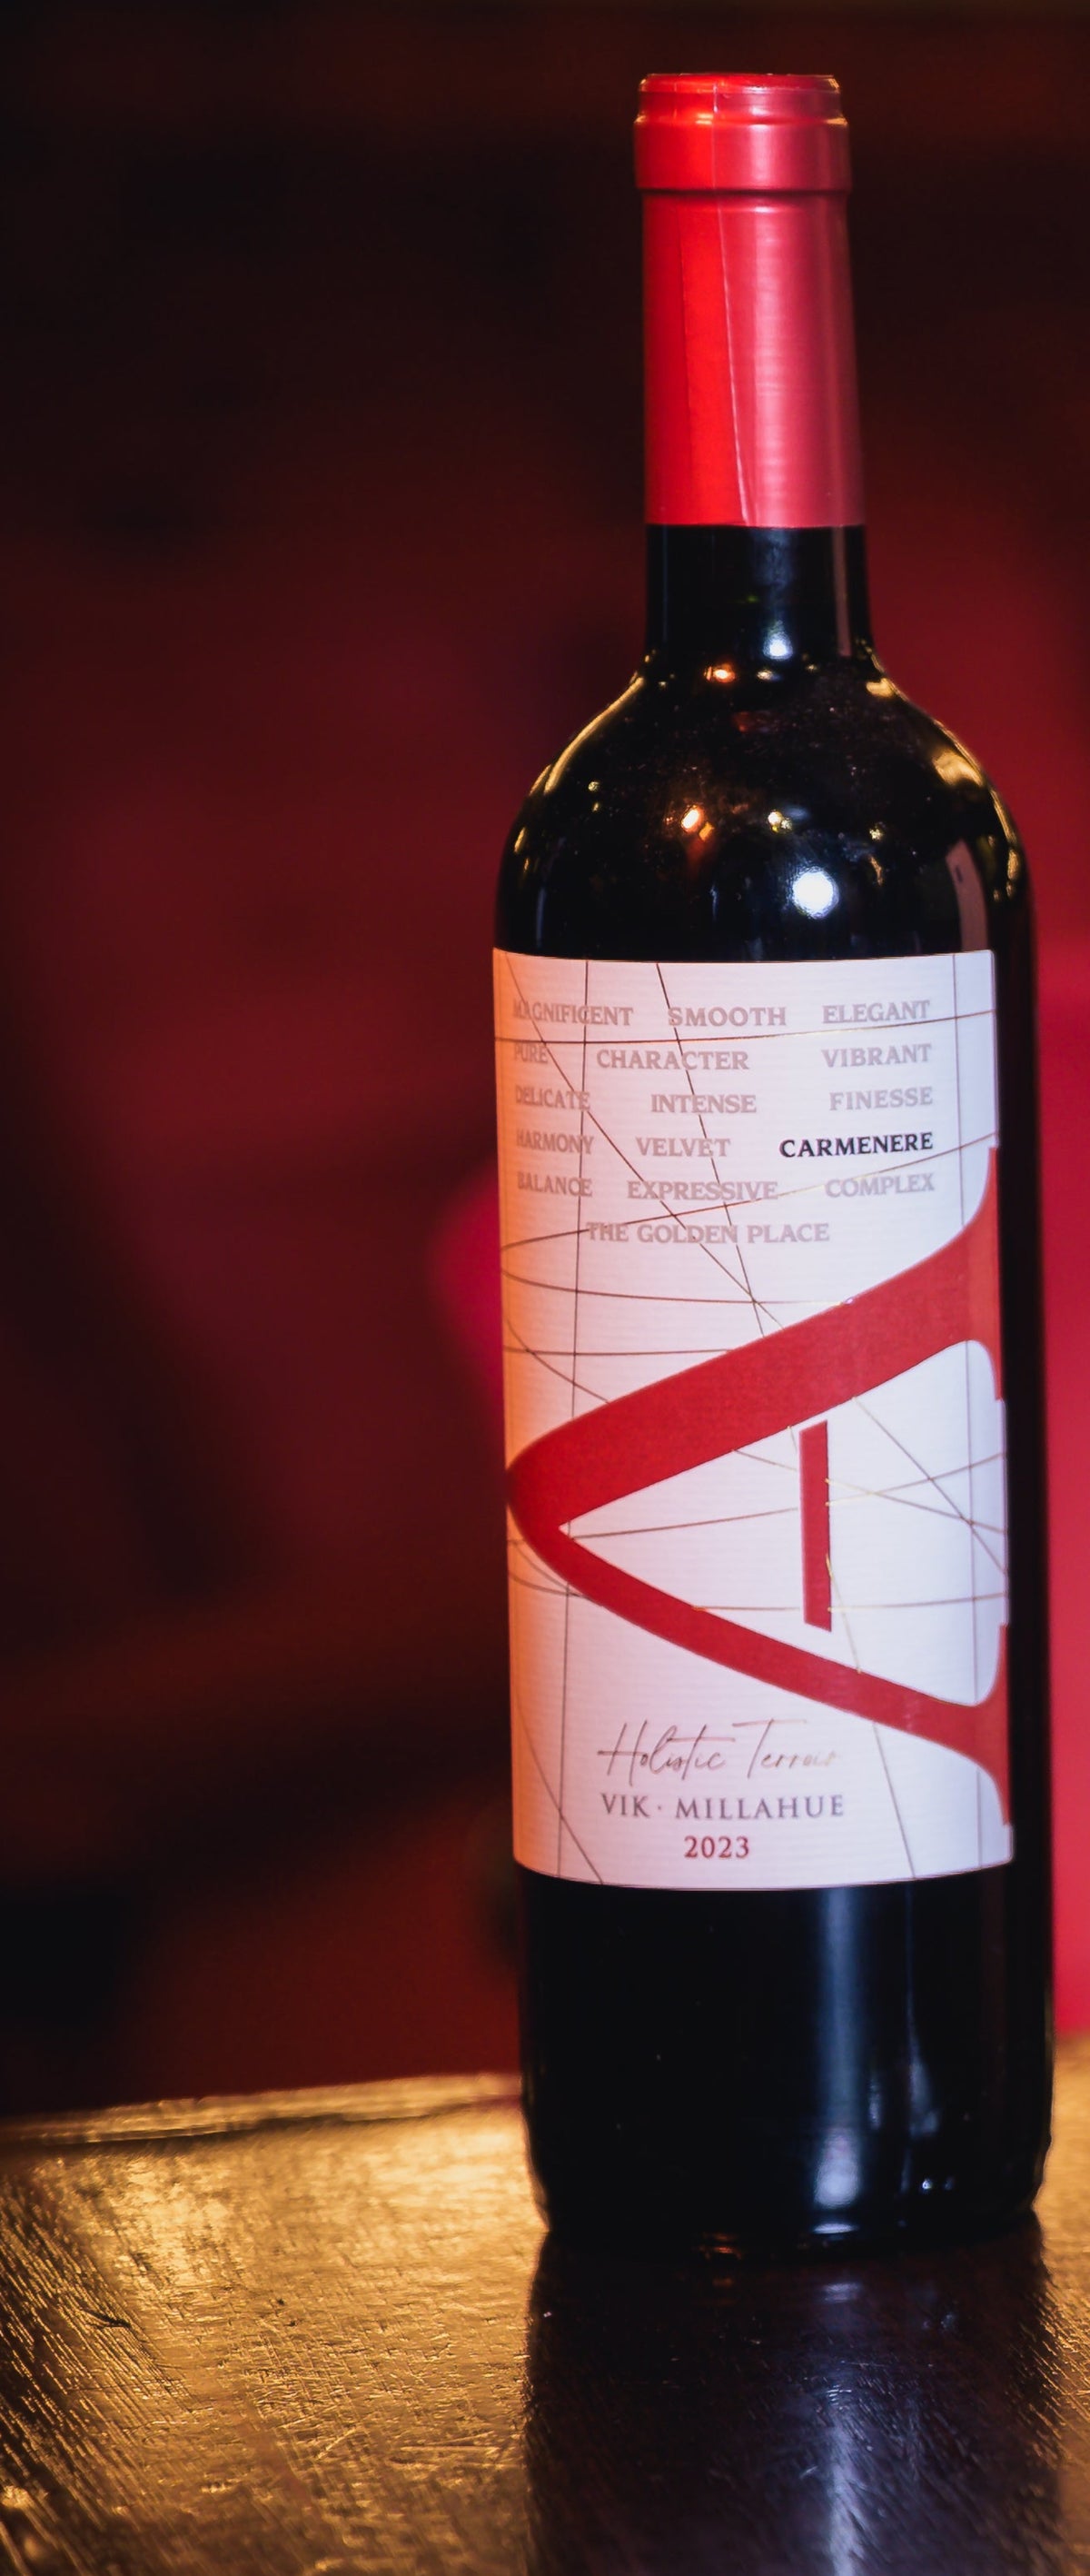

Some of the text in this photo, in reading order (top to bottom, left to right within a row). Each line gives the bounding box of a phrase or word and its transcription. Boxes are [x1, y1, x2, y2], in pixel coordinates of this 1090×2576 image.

[514, 1000, 930, 1026] MAGNIFICENT SMOOTH ELEGANT
[514, 1044, 932, 1069] PURE CHARACTER VIBRANT
[515, 1085, 933, 1114] DELICATE INTENSE FINESSE
[516, 1128, 933, 1158] HARMONY VELVET CARMENERE
[517, 1172, 935, 1200] BALANCE EXPRESSIVE COMPLEX
[587, 1222, 830, 1244] THE GOLDEN PLACE
[598, 1719, 736, 1787] Holistic
[600, 1793, 650, 1817] VIK
[676, 1795, 845, 1821] MILLAHUE
[684, 1835, 749, 1859] 2023
